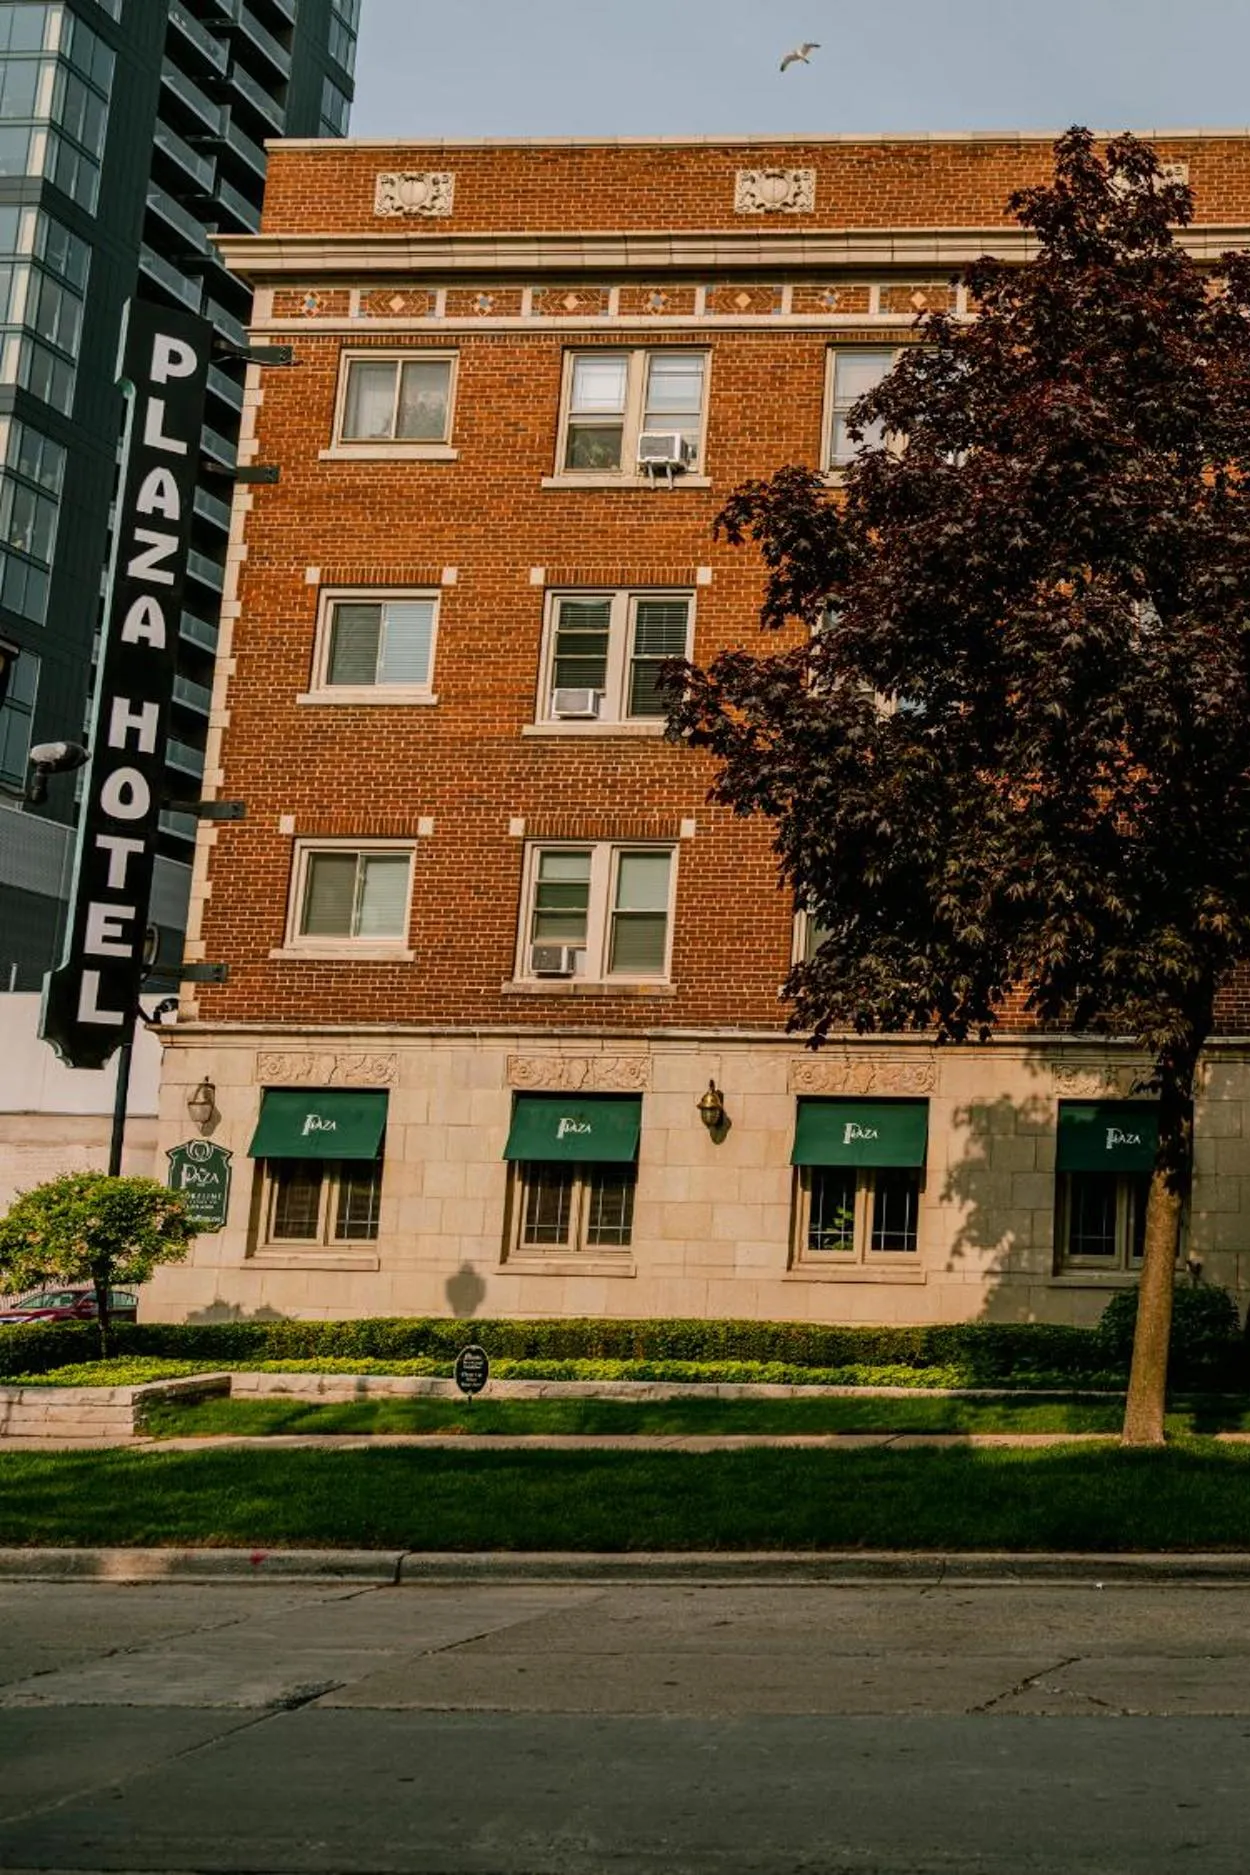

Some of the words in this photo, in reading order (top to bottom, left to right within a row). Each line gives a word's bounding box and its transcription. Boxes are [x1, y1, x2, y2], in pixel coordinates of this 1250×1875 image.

[120, 332, 198, 650] PLAZA
[77, 696, 160, 1027] HOTEL
[301, 1114, 336, 1136] PLAZA
[556, 1117, 592, 1139] PLAZA
[843, 1123, 878, 1144] PLAZA
[1106, 1128, 1141, 1149] PLAZA
